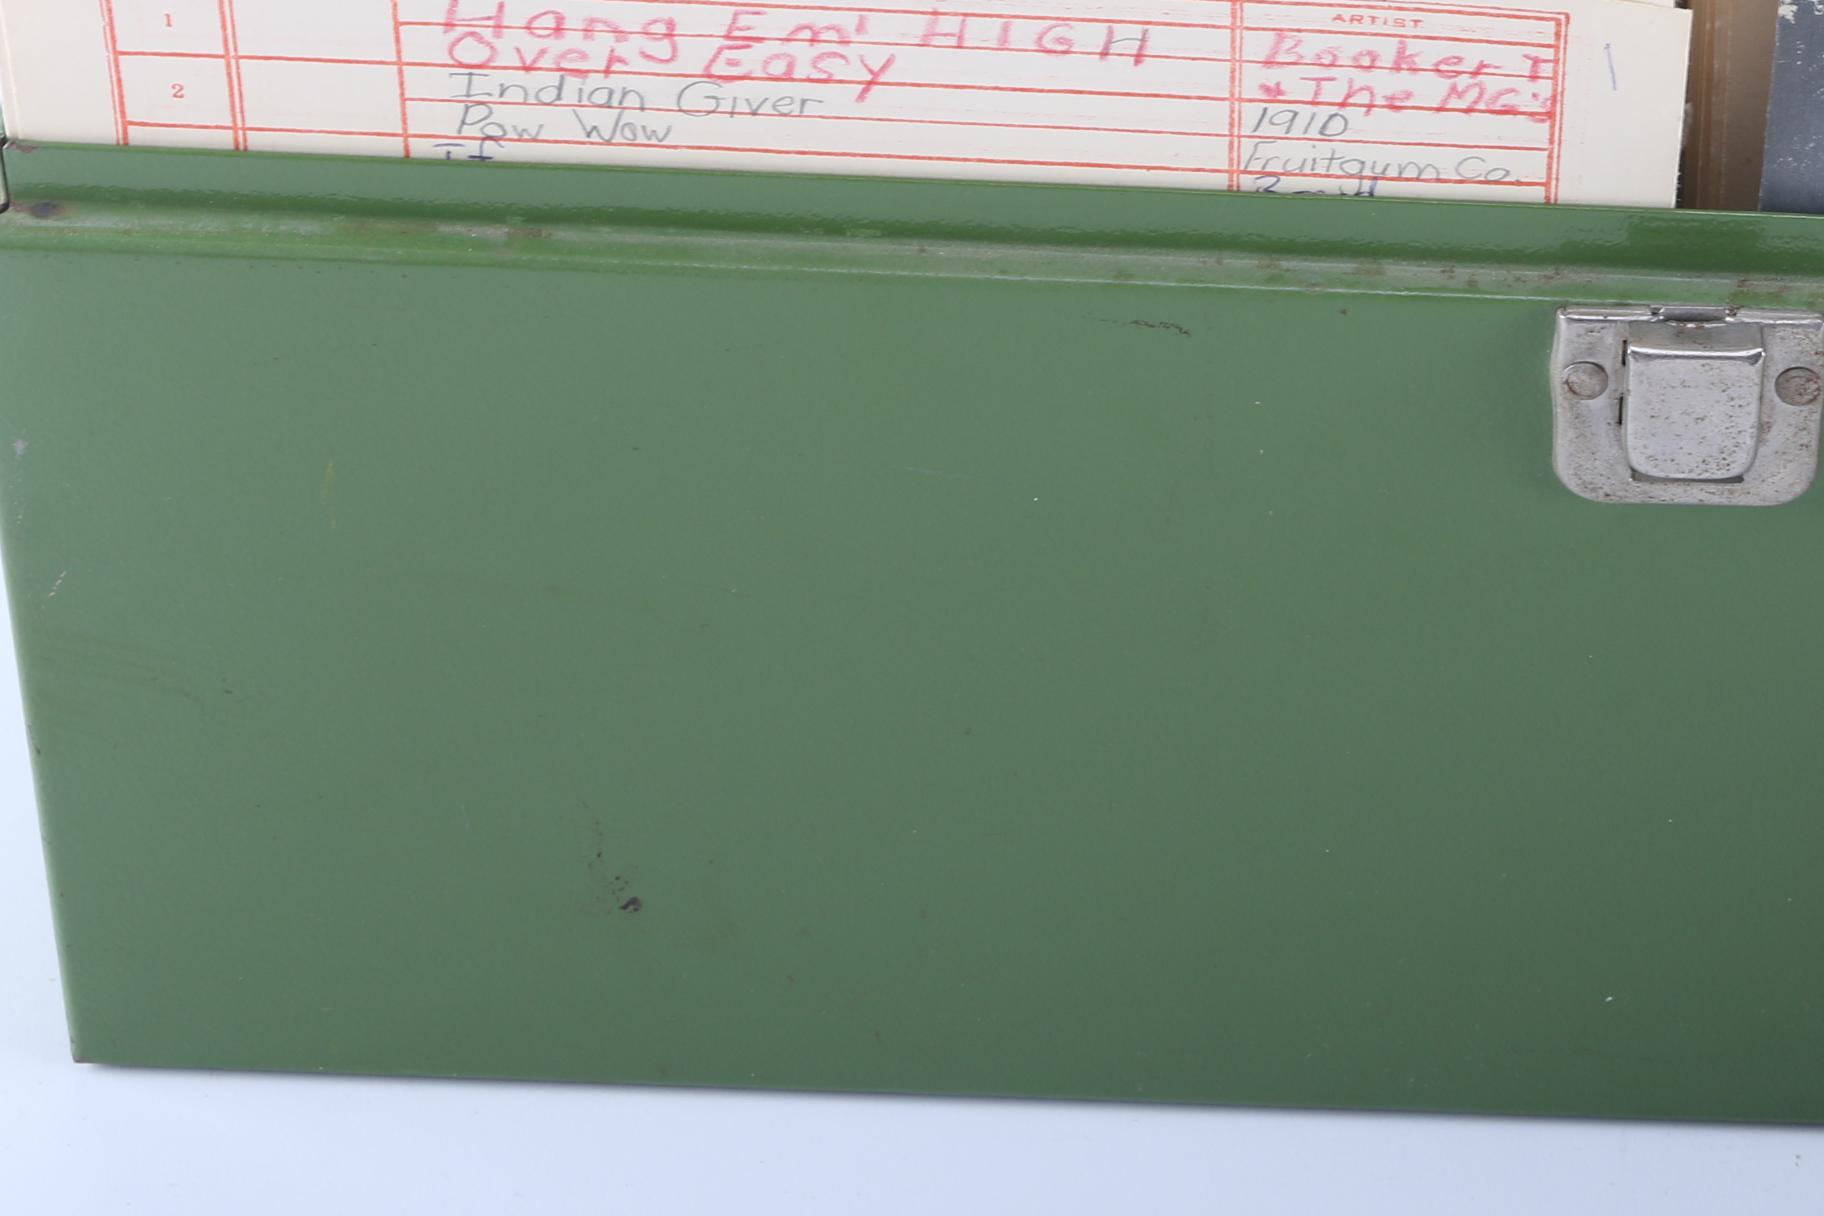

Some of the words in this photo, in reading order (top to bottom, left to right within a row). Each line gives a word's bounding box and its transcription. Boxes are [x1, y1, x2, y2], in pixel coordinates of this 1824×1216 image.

[163, 12, 173, 28] 1
[920, 8, 1150, 67] HIGH
[1331, 12, 1424, 28] ARTIST
[447, 30, 630, 79] Over
[703, 42, 896, 103] Easy
[1261, 31, 1502, 79] Booker
[170, 84, 185, 99] 2
[449, 71, 646, 112] Indian
[677, 80, 824, 118] Giver
[1299, 76, 1414, 116] The
[457, 102, 545, 140] Pow
[572, 109, 672, 144] Wow
[1252, 107, 1349, 137] 1910
[1244, 140, 1440, 195] Fruitgum
